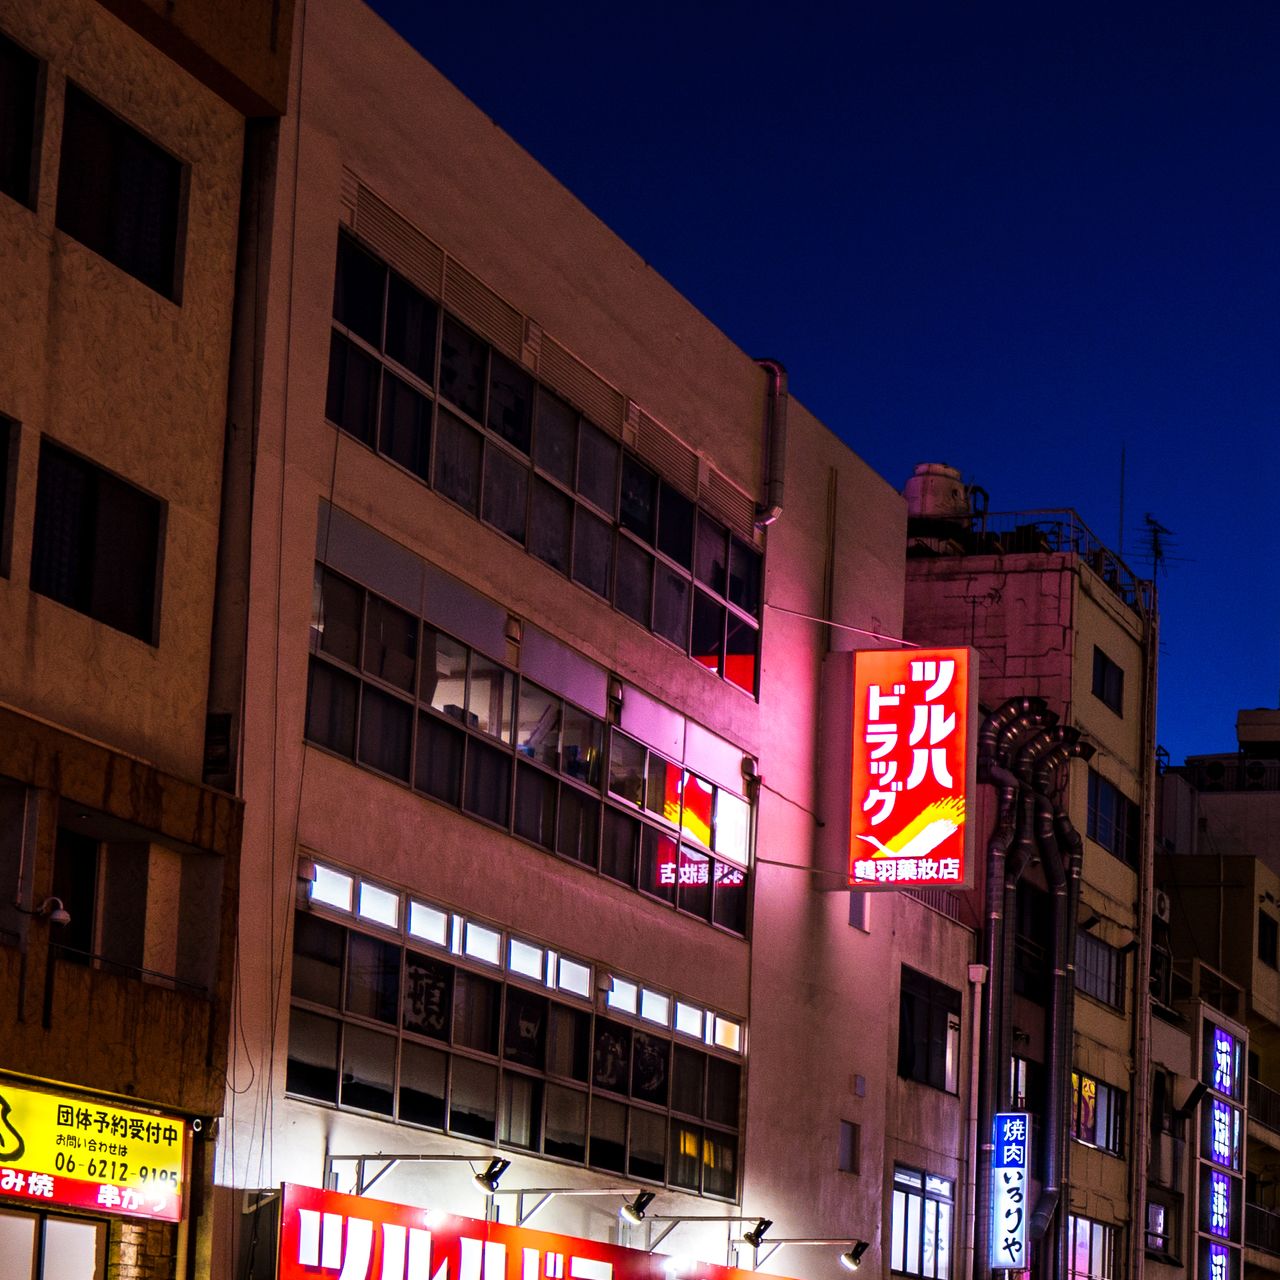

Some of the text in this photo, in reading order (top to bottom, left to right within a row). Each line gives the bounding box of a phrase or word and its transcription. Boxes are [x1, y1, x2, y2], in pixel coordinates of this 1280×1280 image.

[863, 684, 906, 826] ドラッグ
[907, 659, 956, 790] ツルハ
[56, 1133, 128, 1158] お問い合わせは
[57, 1103, 179, 1148] 団体予約受付中
[1002, 1118, 1026, 1263] 焼肉 いろりや
